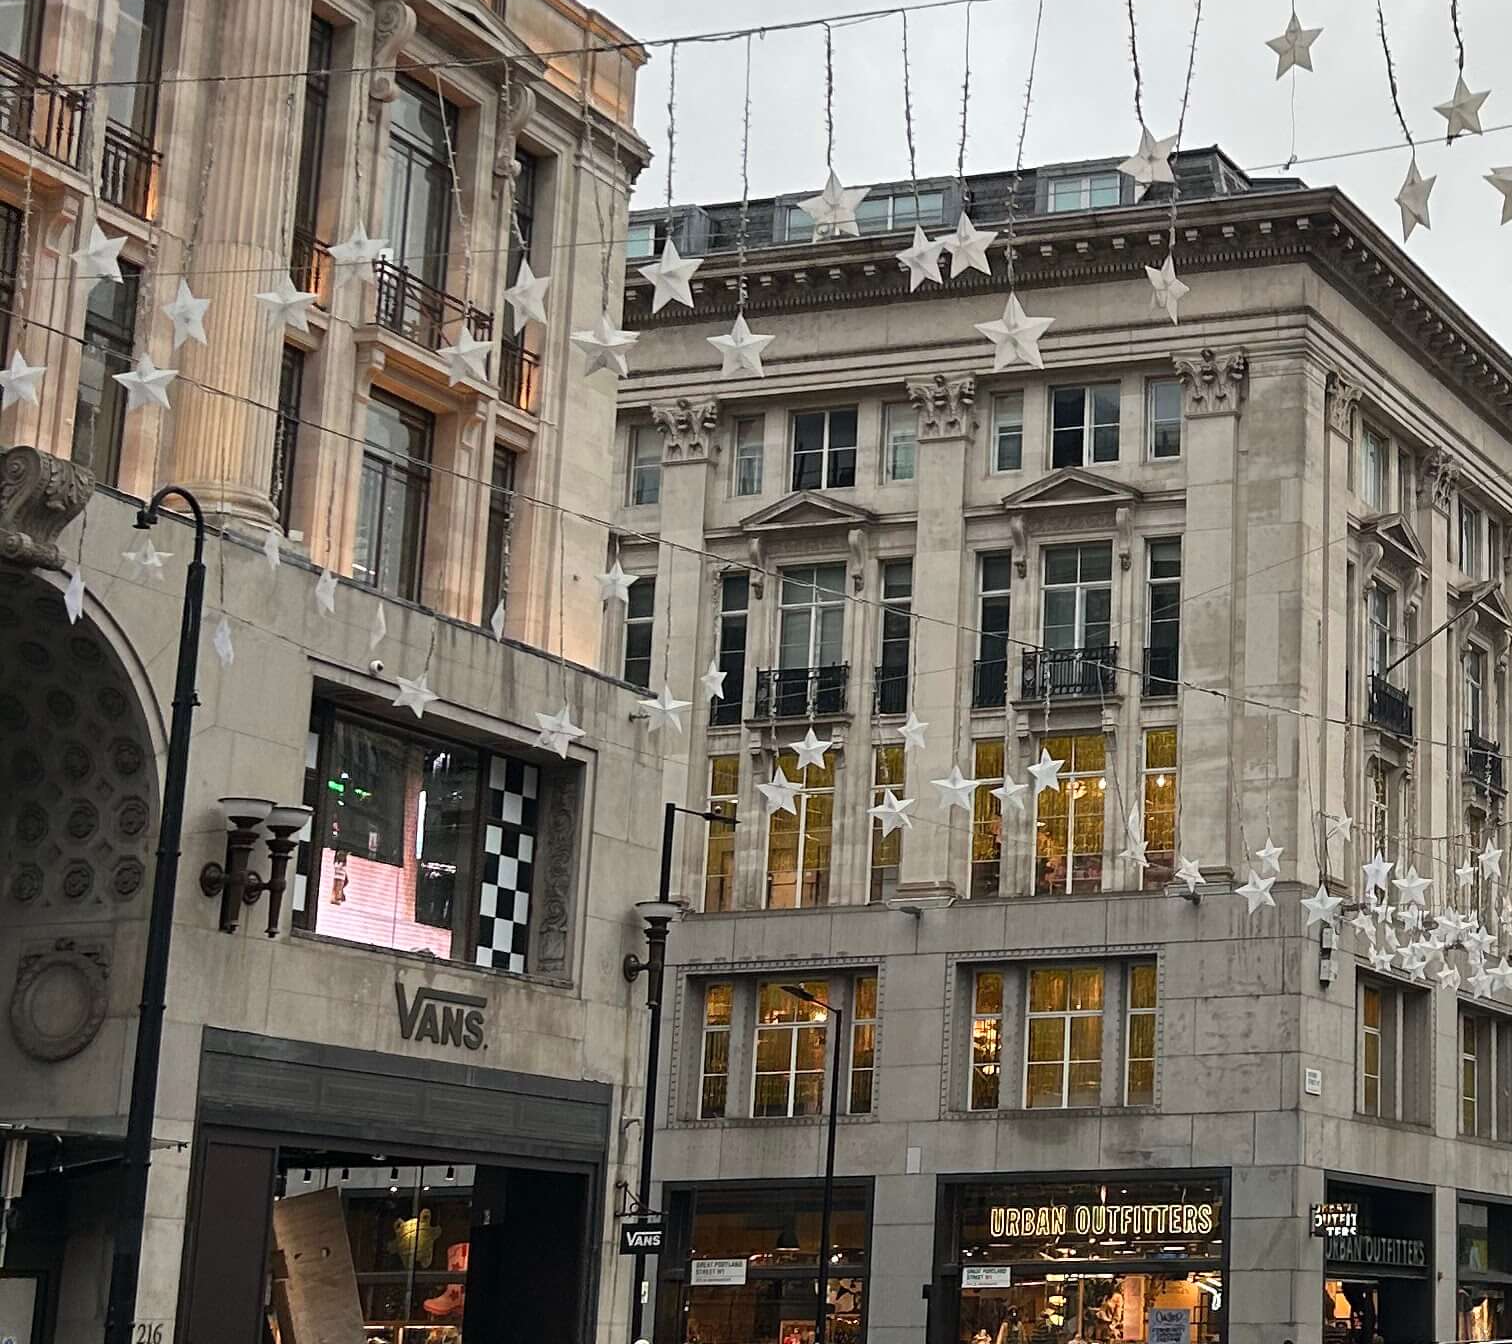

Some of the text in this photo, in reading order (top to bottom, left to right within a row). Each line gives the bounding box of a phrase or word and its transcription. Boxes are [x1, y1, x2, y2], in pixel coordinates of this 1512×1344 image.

[991, 1204, 1212, 1237] URBAN OUTFITTERS
[1314, 1213, 1358, 1227] OUTFIT
[626, 1231, 663, 1246] VANS
[1325, 1226, 1357, 1236] TERS
[1365, 1236, 1425, 1266] OUTFITTERS
